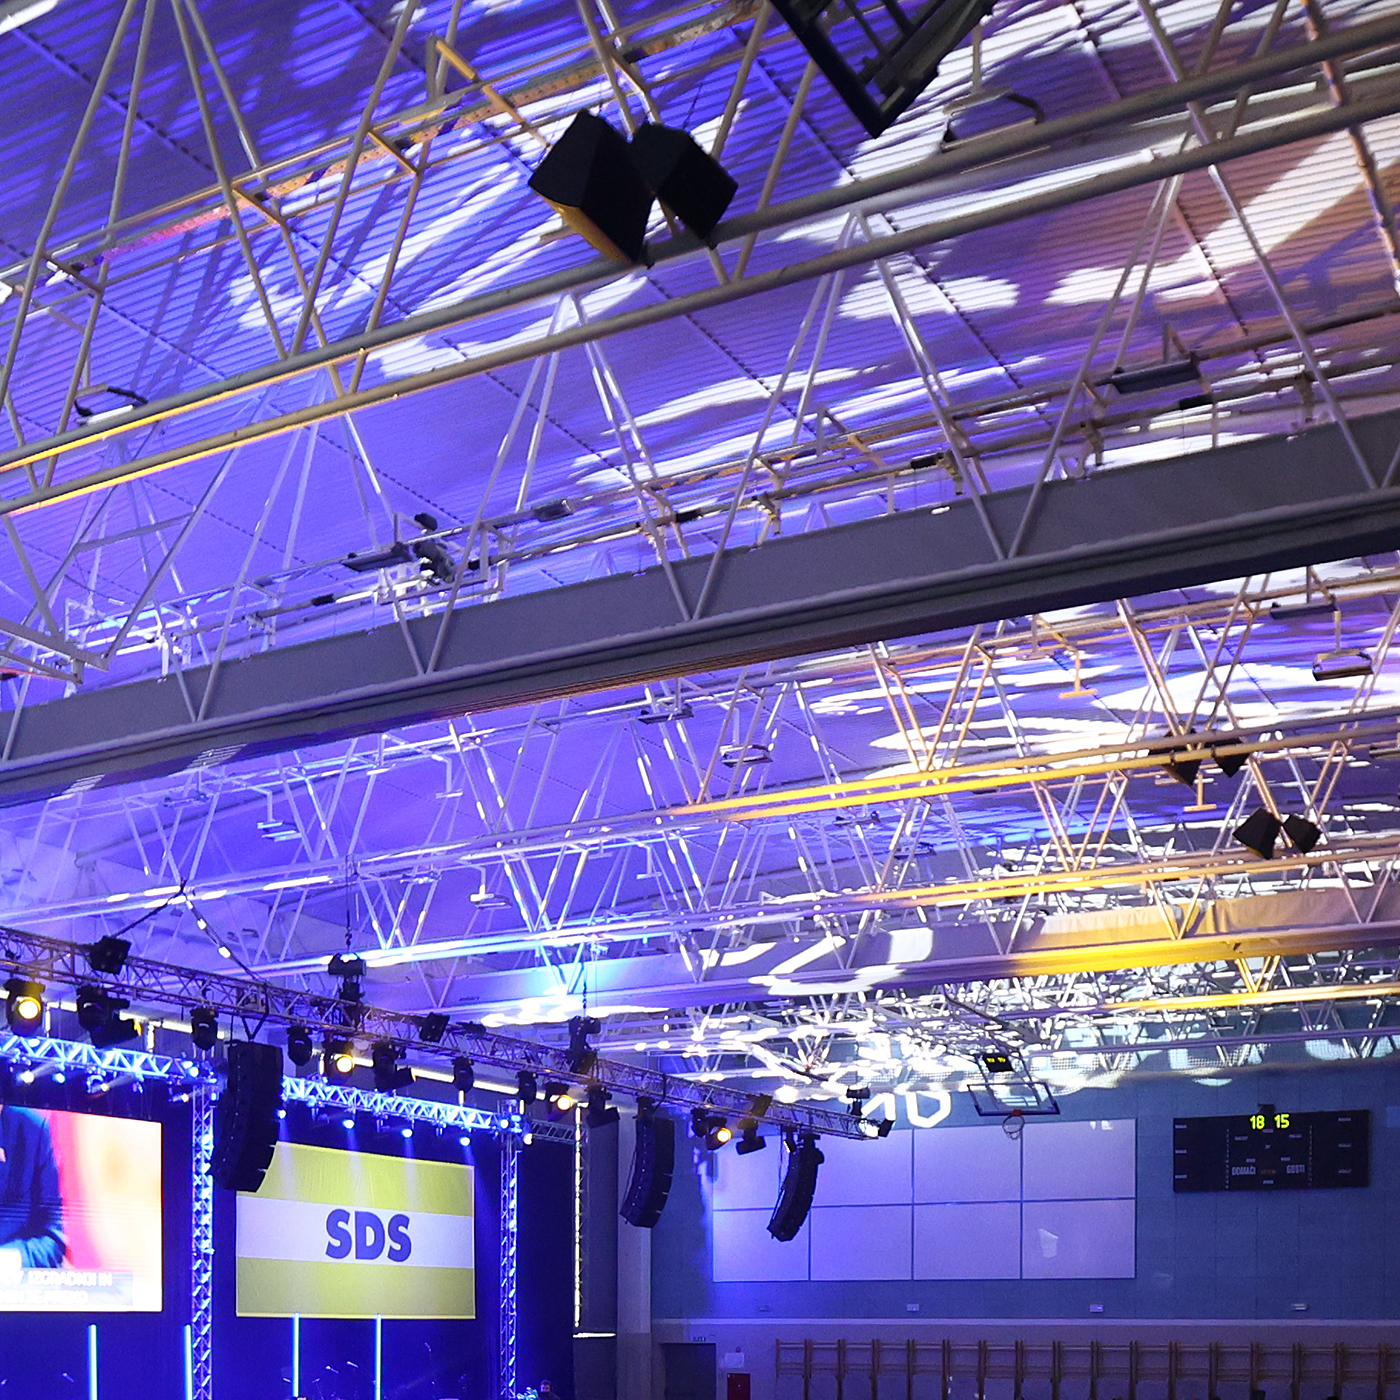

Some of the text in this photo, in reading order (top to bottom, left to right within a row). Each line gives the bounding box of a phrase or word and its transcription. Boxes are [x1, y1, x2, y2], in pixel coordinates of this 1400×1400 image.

[1249, 1113, 1290, 1130] 18 15
[325, 1208, 412, 1263] SDS
